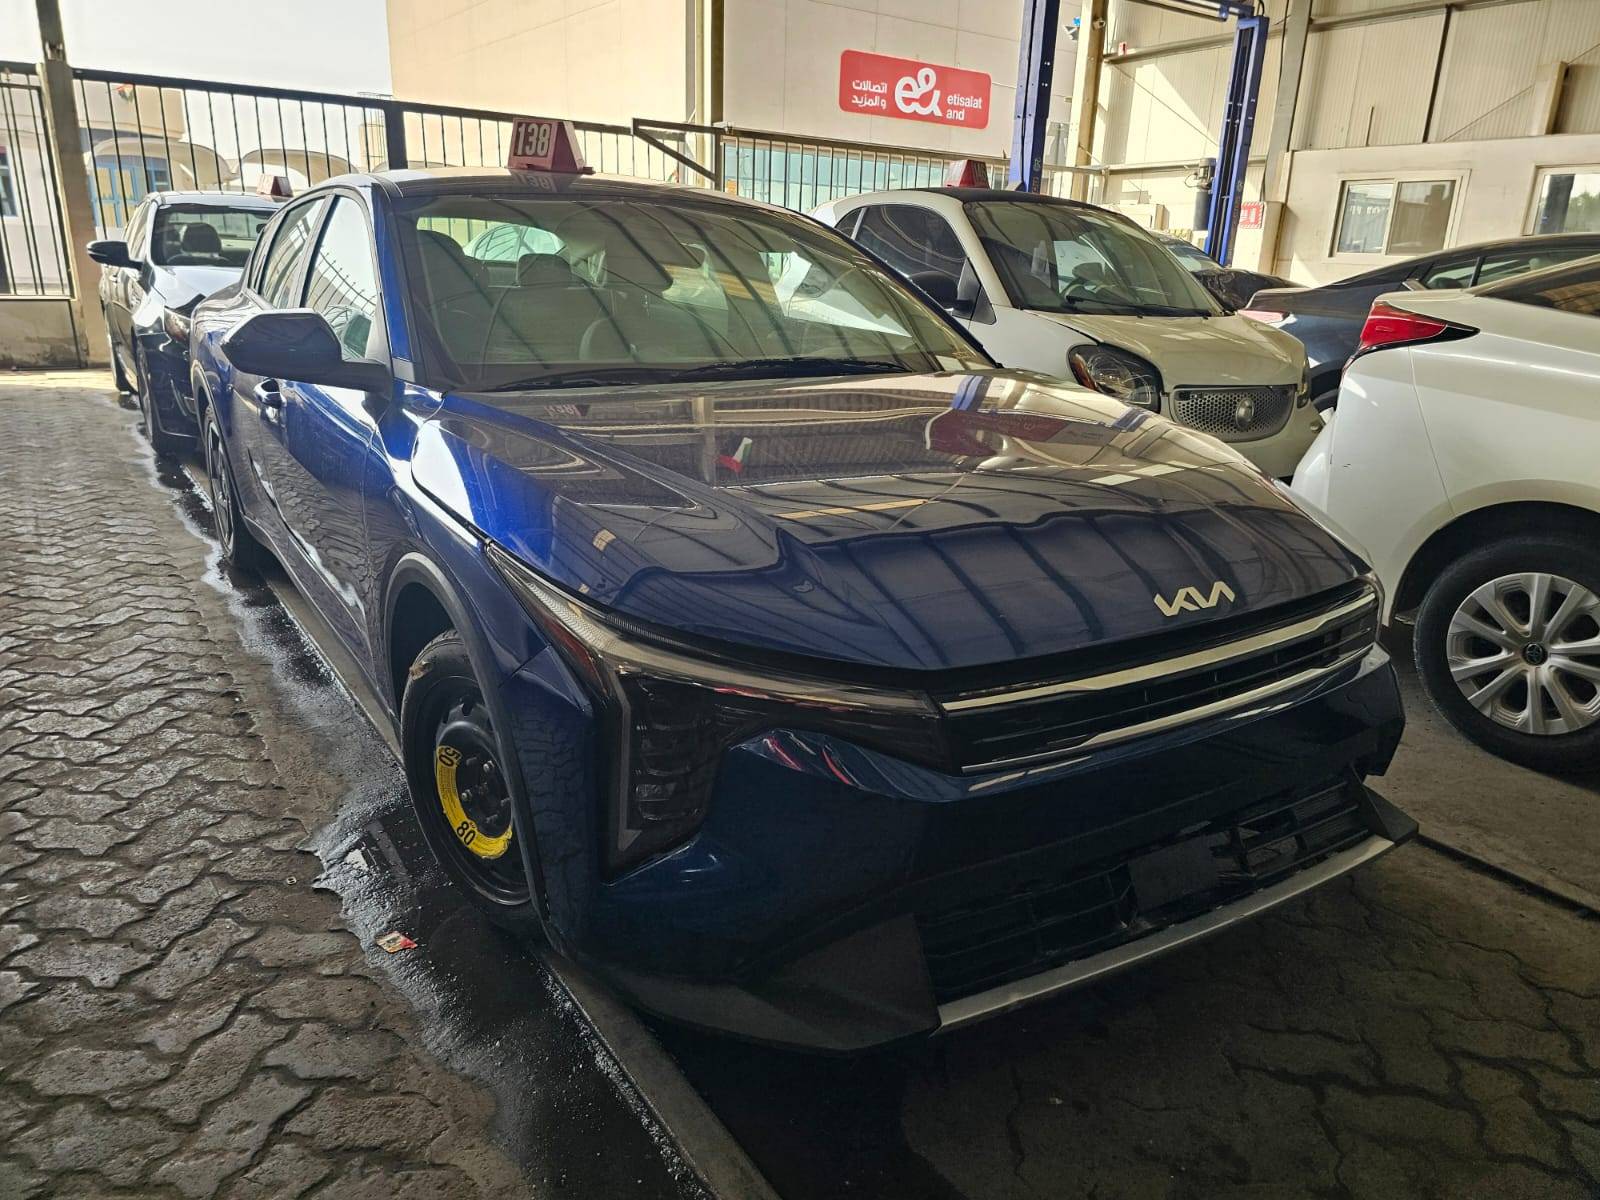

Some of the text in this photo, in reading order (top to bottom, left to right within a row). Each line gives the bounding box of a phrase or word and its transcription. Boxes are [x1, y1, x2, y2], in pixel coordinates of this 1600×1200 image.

[852, 79, 888, 94] اتصالات
[851, 94, 887, 110] والمزيد
[947, 94, 982, 109] etisalat
[946, 108, 965, 121] and
[516, 123, 551, 157] 138
[1153, 581, 1236, 617] KIA
[438, 746, 461, 767] 50
[456, 821, 476, 846] 80
